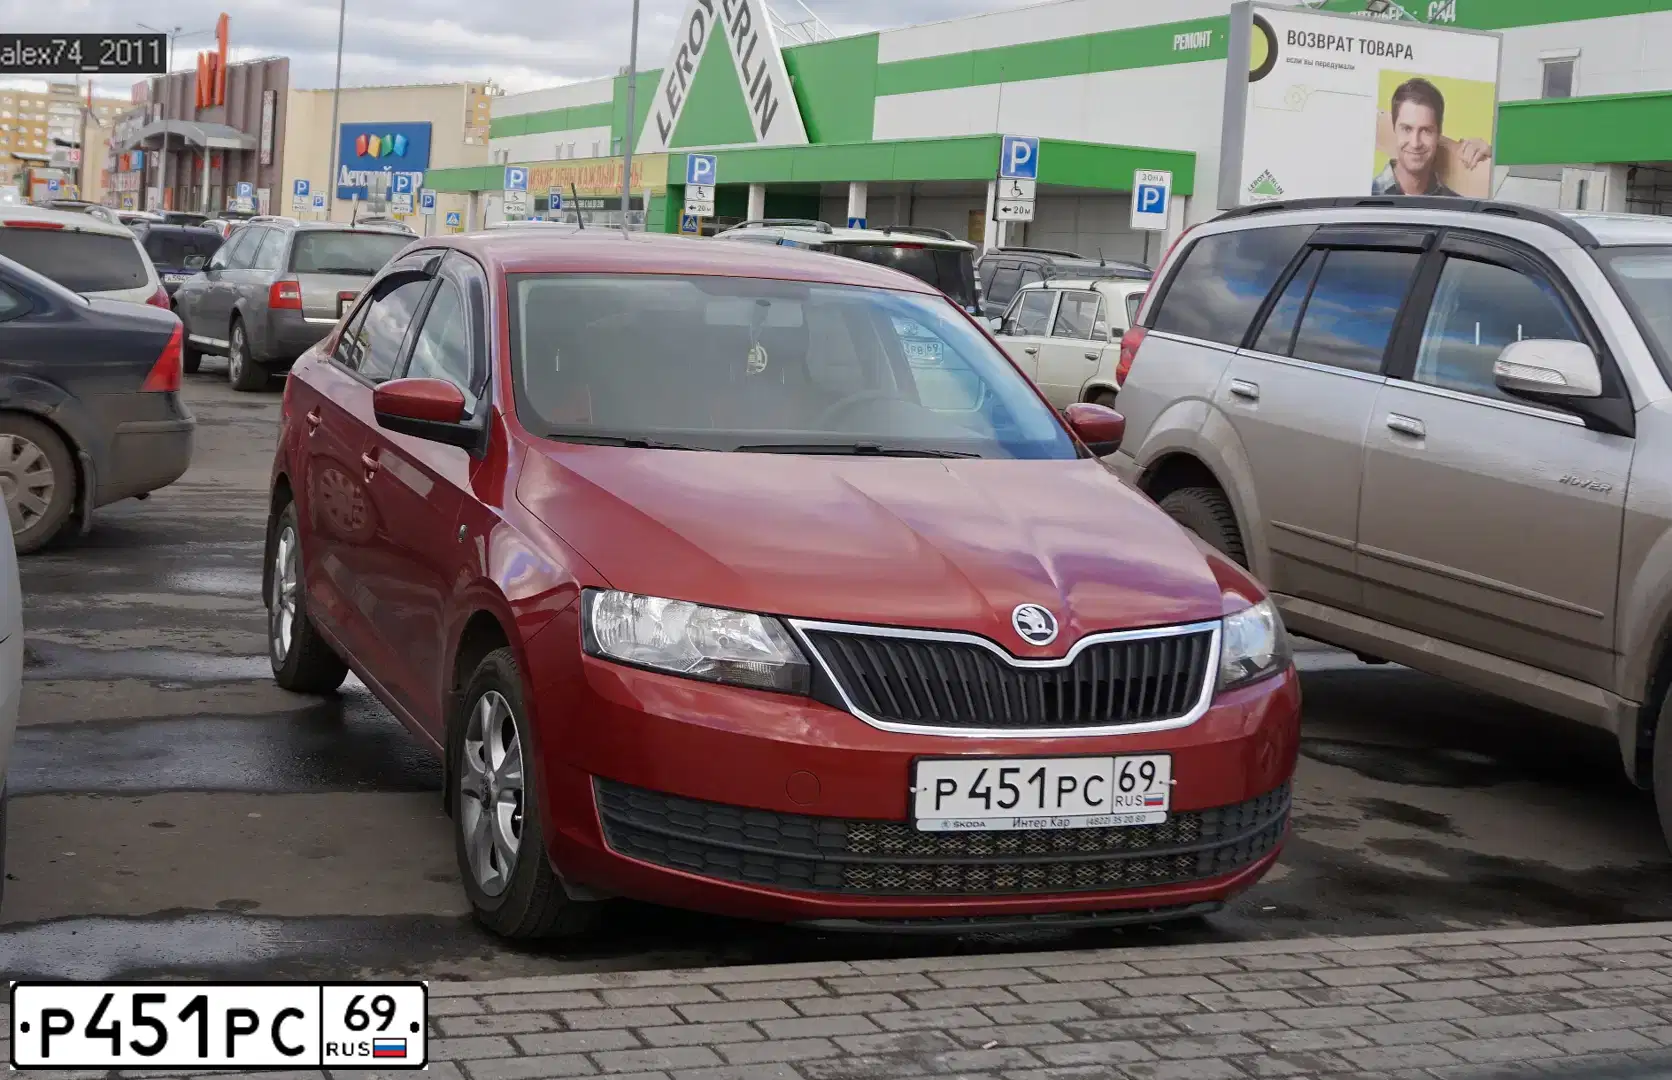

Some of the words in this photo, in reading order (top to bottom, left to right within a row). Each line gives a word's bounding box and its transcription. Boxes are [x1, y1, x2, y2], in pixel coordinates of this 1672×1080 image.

[1173, 30, 1213, 51] РЕМОНТ
[1287, 29, 1355, 53] ВОЗВРАТ
[1358, 38, 1414, 61] ТОВАРА
[694, 157, 711, 181] P
[1010, 141, 1031, 173] P
[510, 169, 524, 188] P
[1143, 187, 1160, 211] P
[1119, 760, 1156, 793] 69
[1115, 795, 1143, 807] RUS
[1012, 816, 1047, 829] Интер
[1050, 815, 1071, 828] Кар
